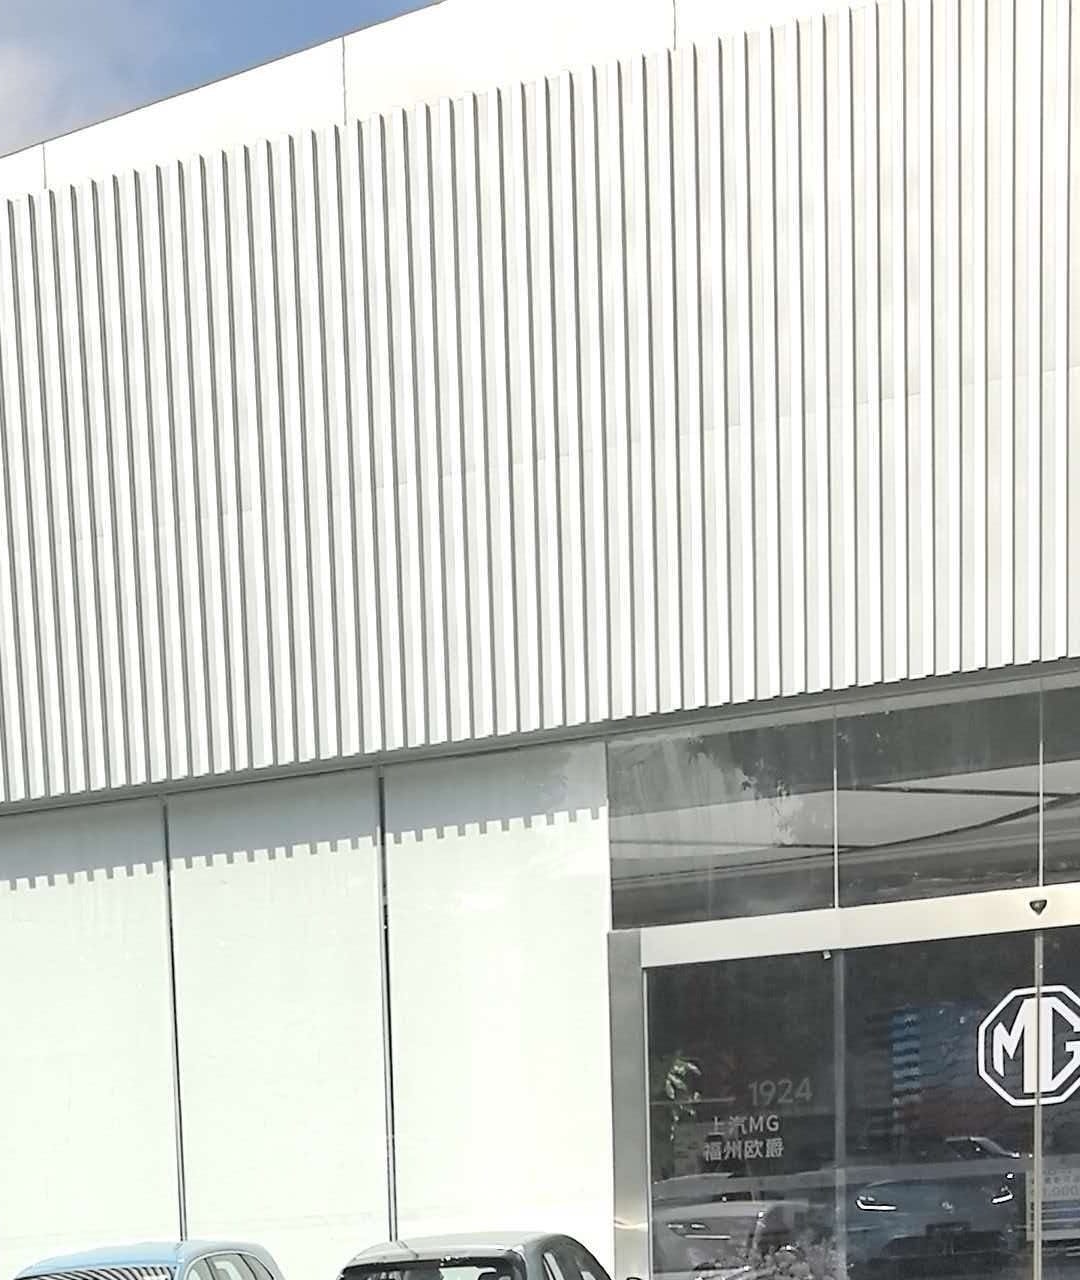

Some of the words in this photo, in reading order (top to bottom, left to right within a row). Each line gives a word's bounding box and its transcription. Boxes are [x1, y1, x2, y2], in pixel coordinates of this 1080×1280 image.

[991, 995, 1080, 1094] MG
[748, 1077, 813, 1106] 1924
[708, 1115, 780, 1135] 上汽MG
[704, 1137, 785, 1162] 福州欧爵
